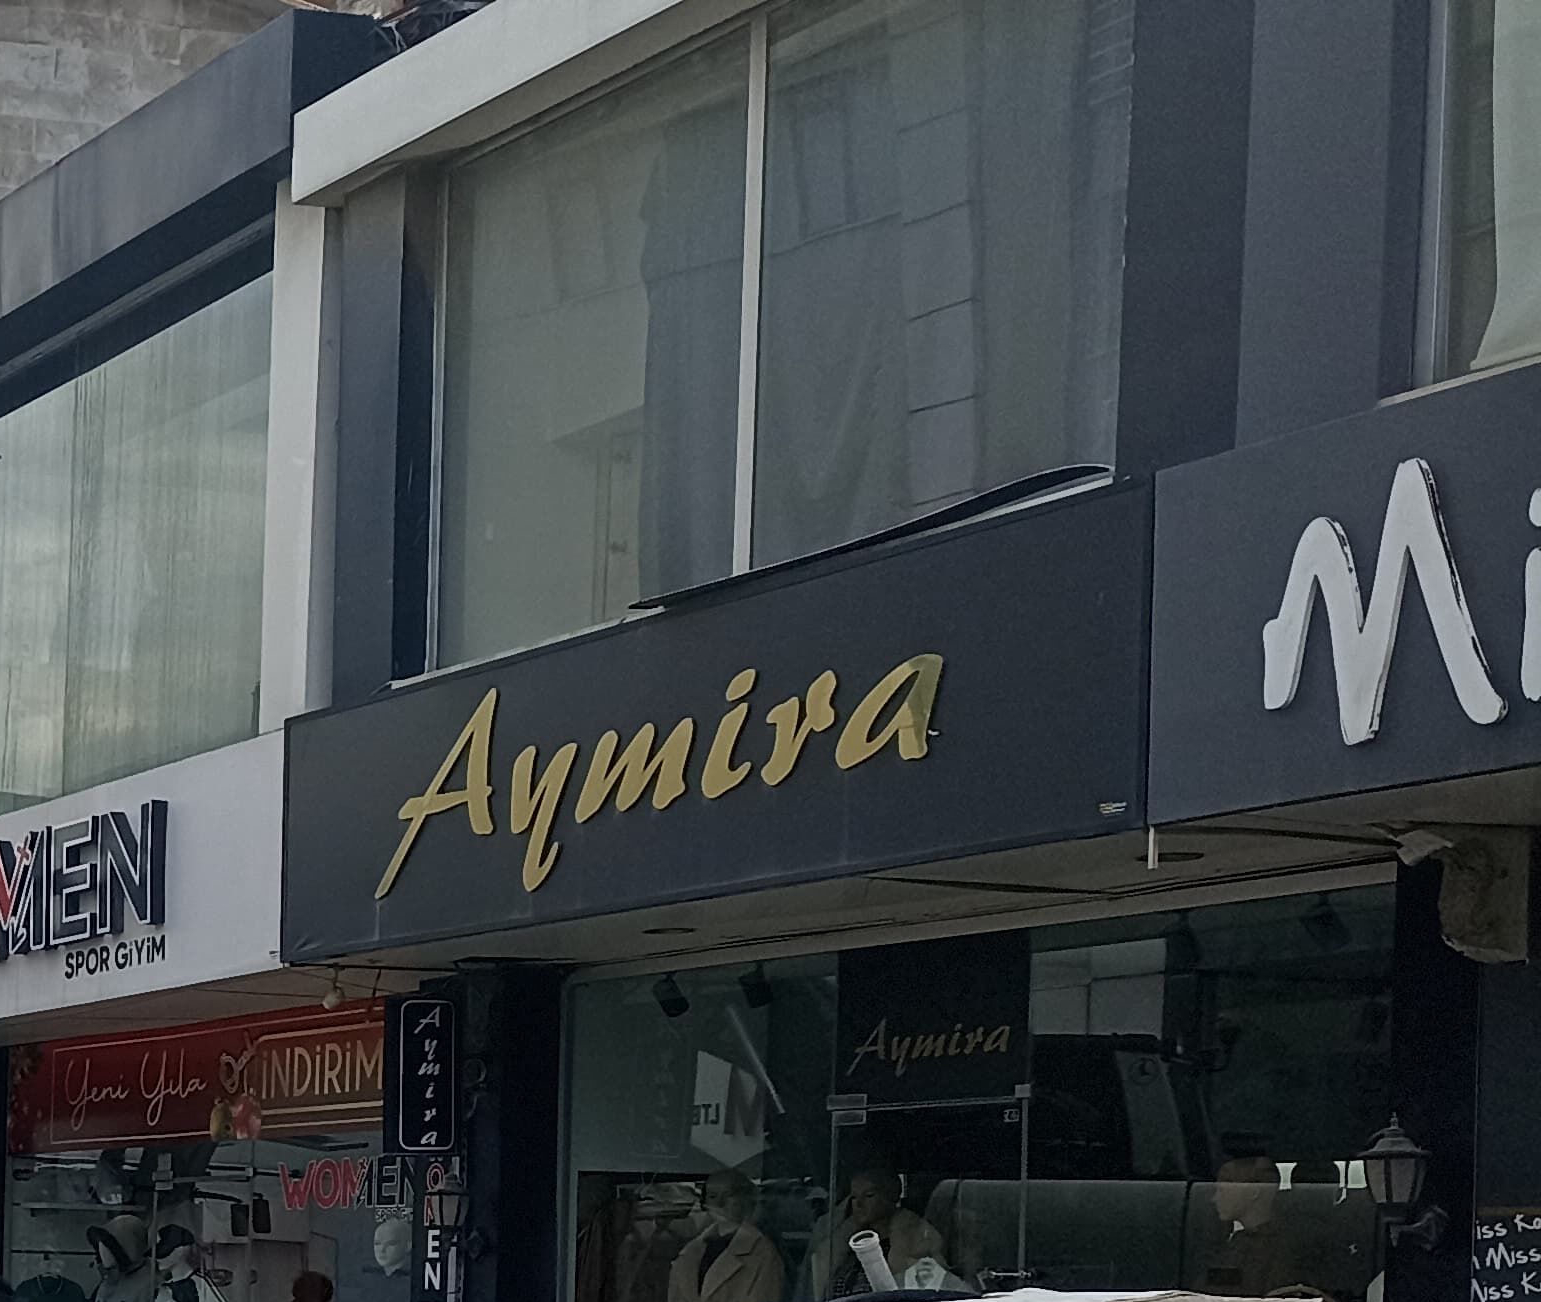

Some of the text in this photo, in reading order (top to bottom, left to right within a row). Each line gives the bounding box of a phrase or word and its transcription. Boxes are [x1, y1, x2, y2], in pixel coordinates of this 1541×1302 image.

[373, 652, 944, 900] Aymira
[65, 945, 110, 979] SPOR
[414, 1006, 443, 1146] Aymira
[845, 1016, 1011, 1078] Aymira
[66, 1057, 130, 1131] Yeni
